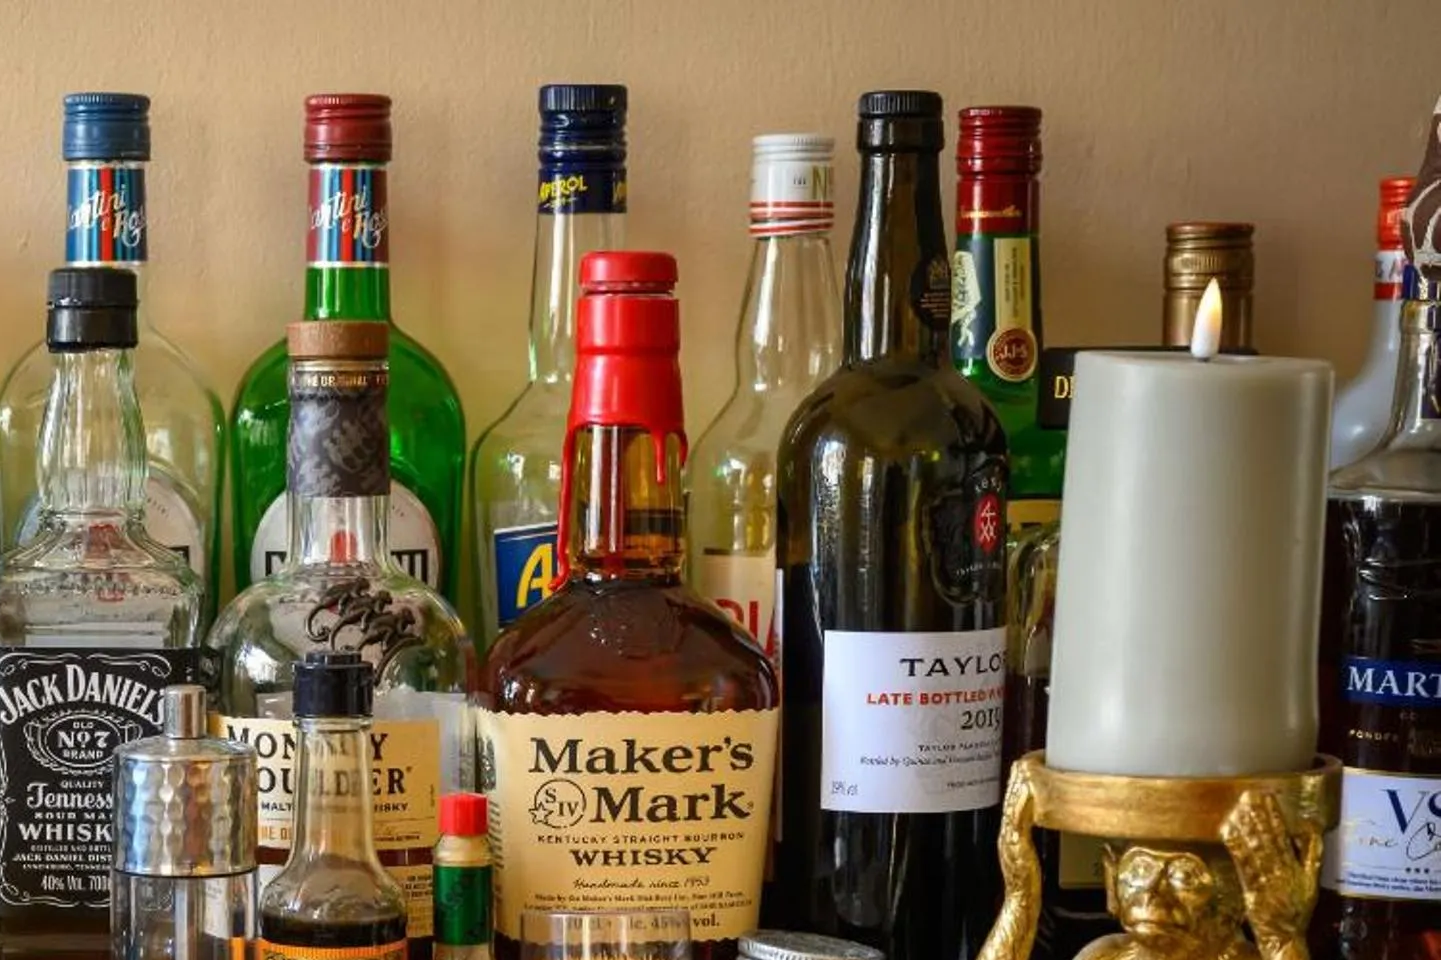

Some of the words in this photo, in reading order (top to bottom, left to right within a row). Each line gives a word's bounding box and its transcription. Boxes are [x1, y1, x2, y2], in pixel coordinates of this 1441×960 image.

[1346, 665, 1441, 699] MART
[867, 692, 911, 706] LATE
[919, 690, 986, 705] BOTTLED
[72, 721, 95, 729] OLD
[62, 750, 104, 760] BRAND
[528, 736, 755, 775] Maker's
[60, 780, 105, 789] QUALITY
[26, 782, 113, 809] Tenness
[589, 783, 752, 823] Mark
[18, 823, 113, 842] WHISK
[537, 834, 607, 845] KENTUCKY
[612, 834, 678, 844] STRAIGHT
[684, 831, 745, 843] BOURBON
[569, 846, 717, 867] WHISKY
